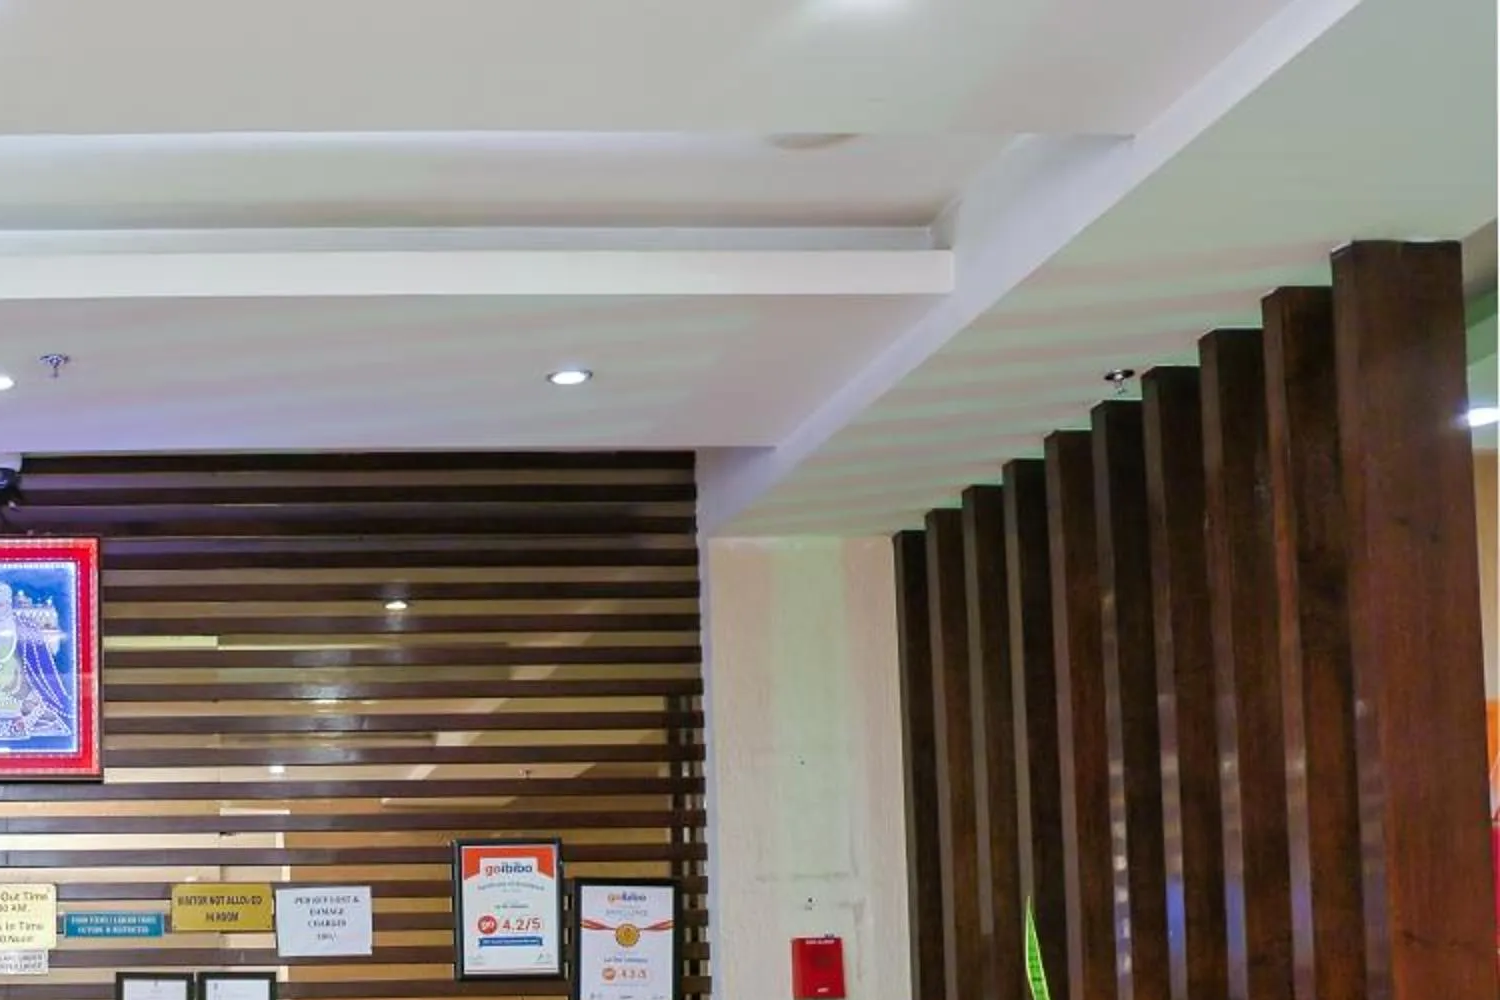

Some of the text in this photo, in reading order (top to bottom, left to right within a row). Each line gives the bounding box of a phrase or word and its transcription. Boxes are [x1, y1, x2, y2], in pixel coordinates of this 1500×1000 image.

[485, 861, 533, 876] goibibo
[0, 891, 21, 902] Out
[23, 891, 49, 902] Time
[209, 895, 225, 906] NOT
[215, 911, 240, 922] ROOM
[19, 921, 45, 932] Time
[502, 917, 541, 931] 4.2/5
